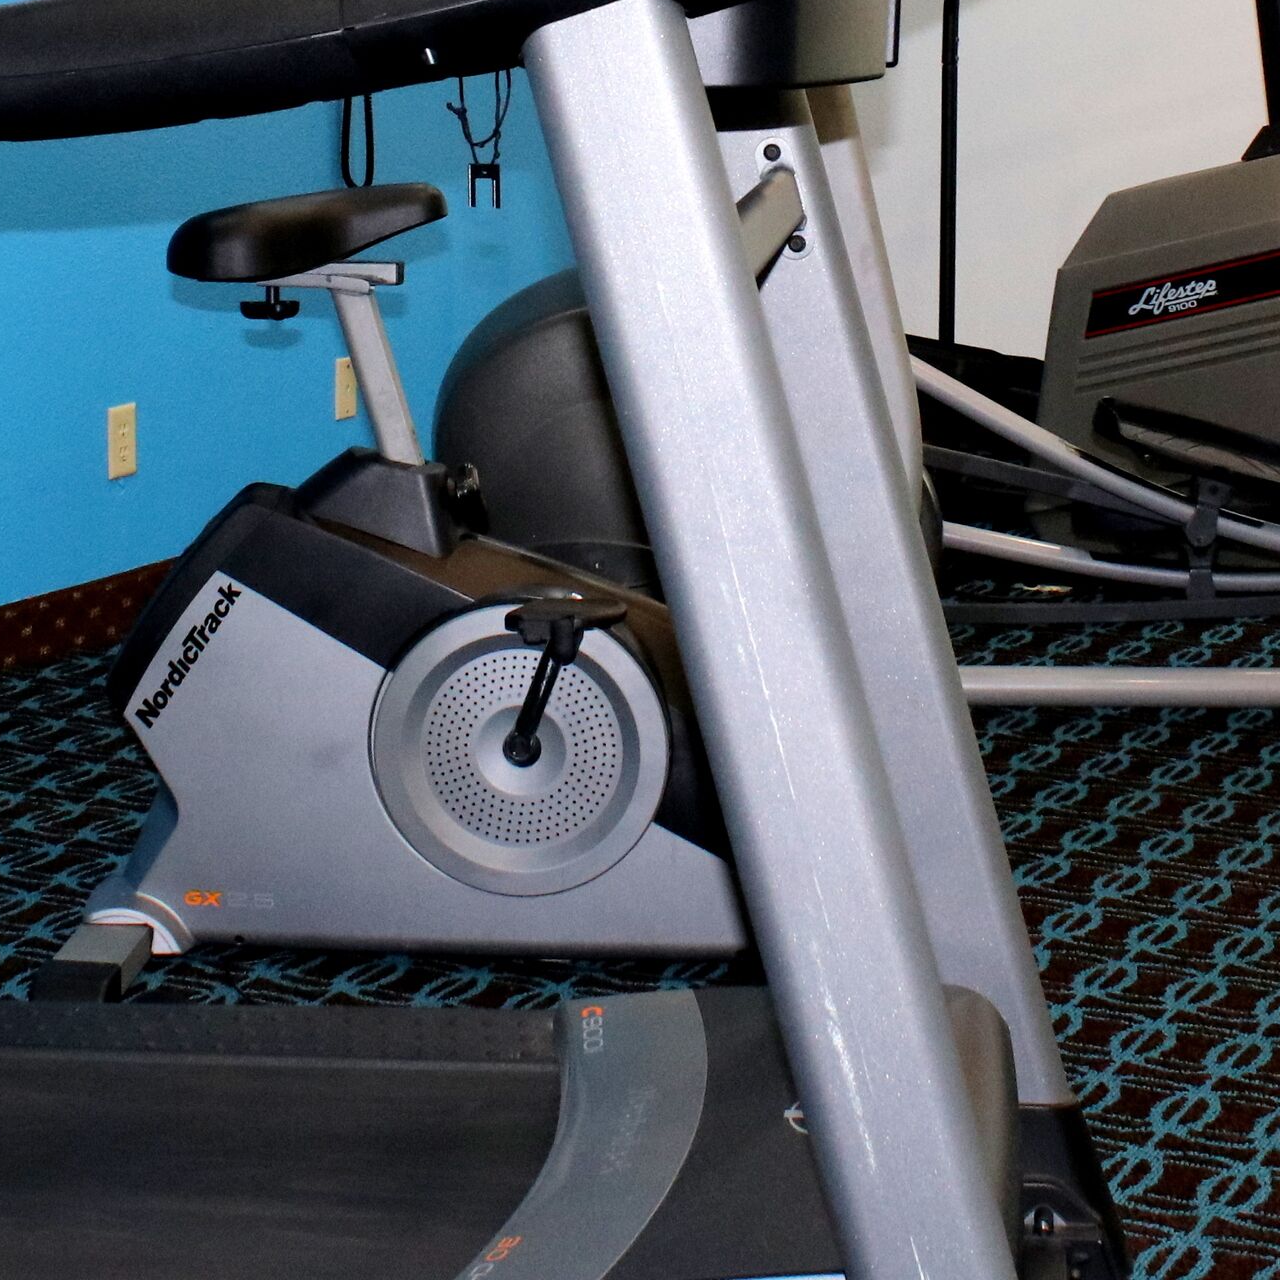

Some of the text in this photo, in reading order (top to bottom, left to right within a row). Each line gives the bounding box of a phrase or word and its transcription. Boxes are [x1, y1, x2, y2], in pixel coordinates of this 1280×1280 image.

[1128, 279, 1218, 316] Lifestep
[1167, 299, 1198, 313] 9100
[134, 582, 243, 730] NordicTrack
[183, 890, 223, 907] GX
